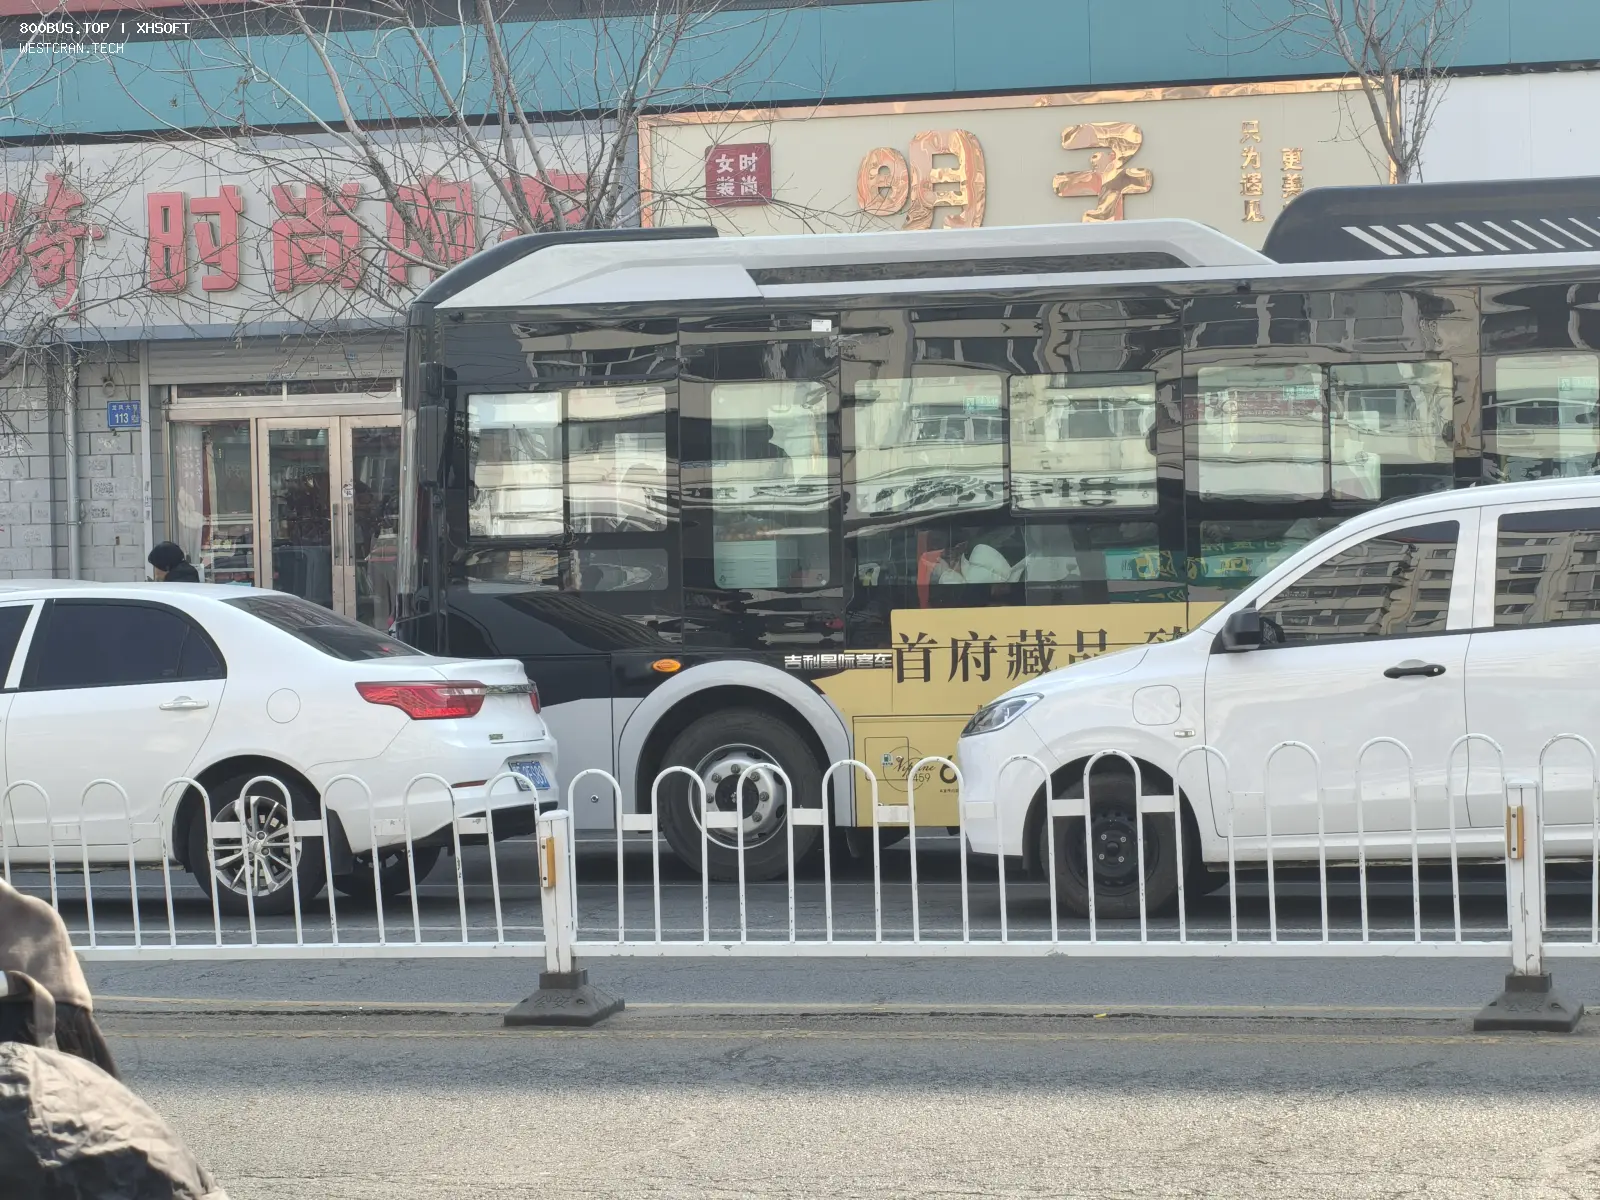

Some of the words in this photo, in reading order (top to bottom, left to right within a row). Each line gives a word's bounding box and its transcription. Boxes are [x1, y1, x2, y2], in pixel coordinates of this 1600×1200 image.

[1280, 147, 1304, 209] 更美
[784, 653, 893, 670] 吉利星际客车
